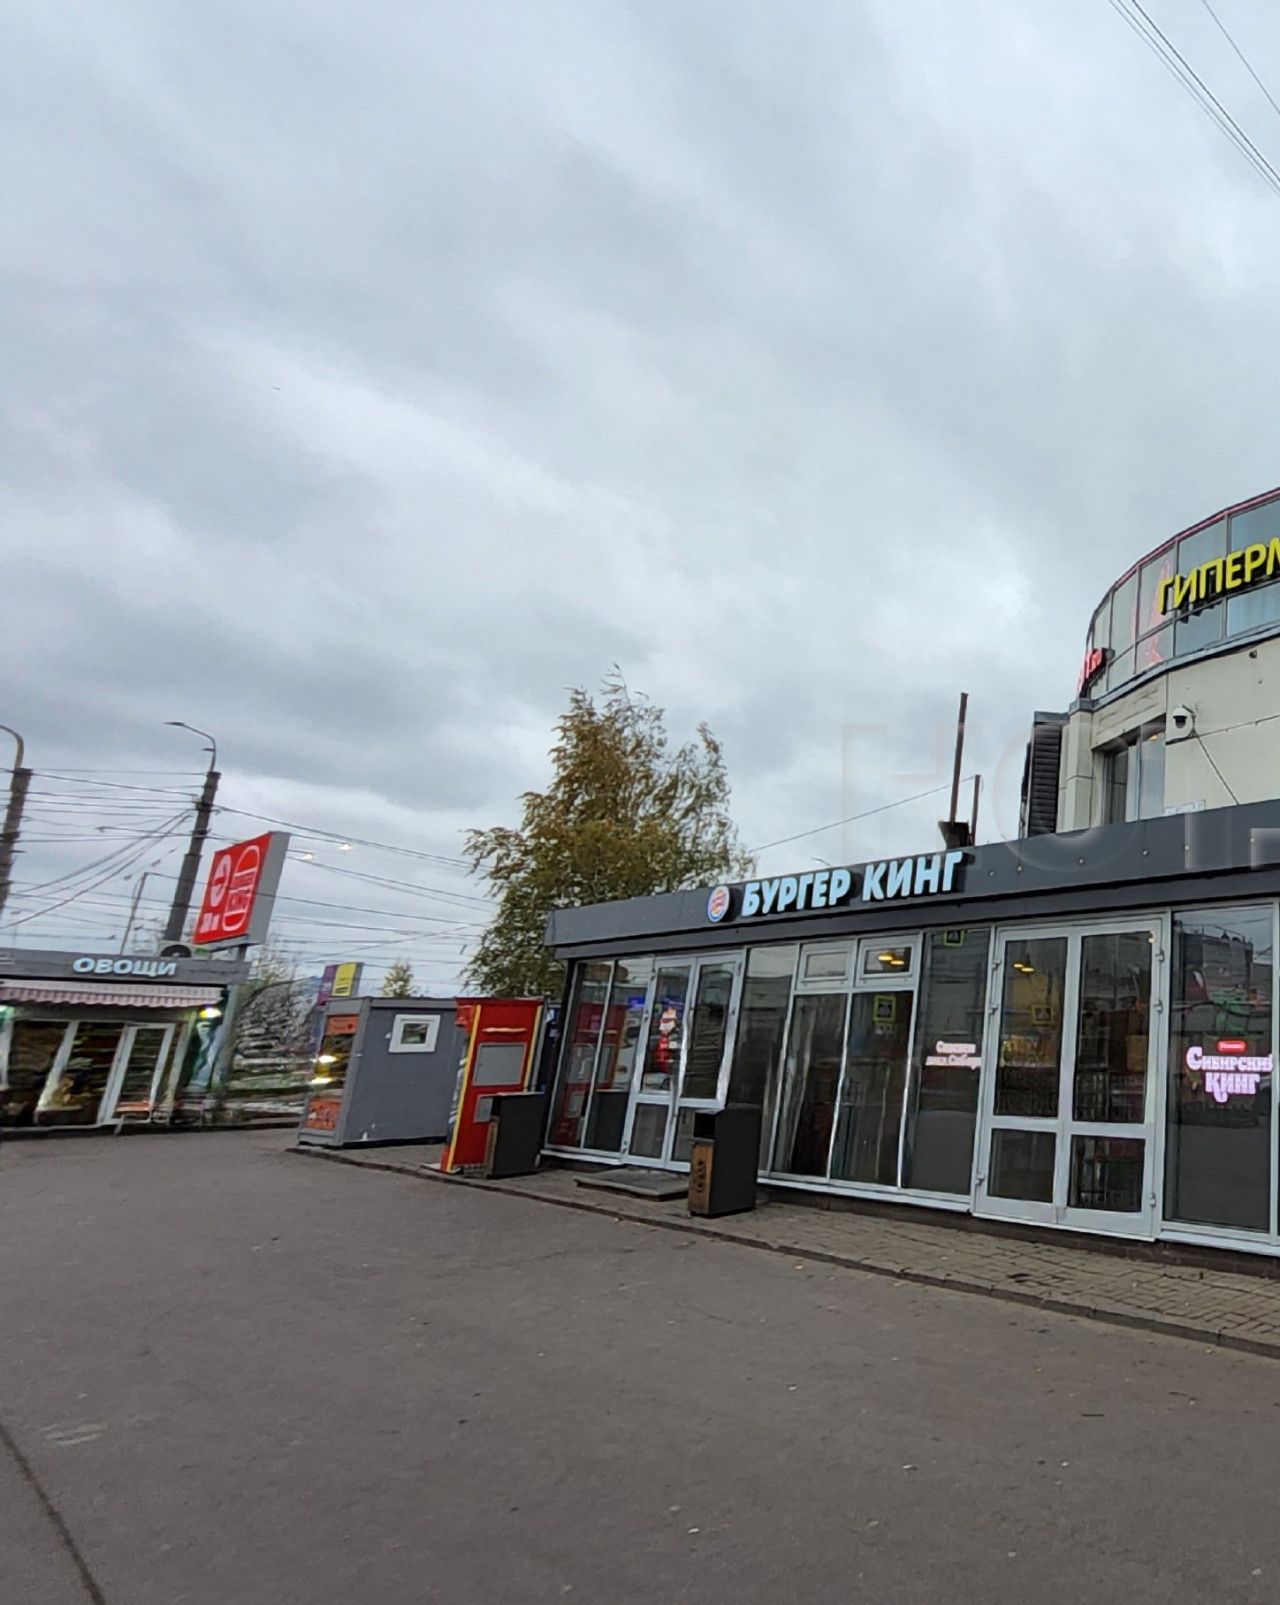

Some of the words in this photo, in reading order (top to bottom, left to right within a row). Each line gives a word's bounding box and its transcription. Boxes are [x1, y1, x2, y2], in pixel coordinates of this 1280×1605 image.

[741, 868, 851, 917] БУРГЕР
[862, 851, 964, 902] КИНГ
[73, 957, 177, 977] ОВОЩИ
[1205, 1072, 1260, 1103] КИНГ
